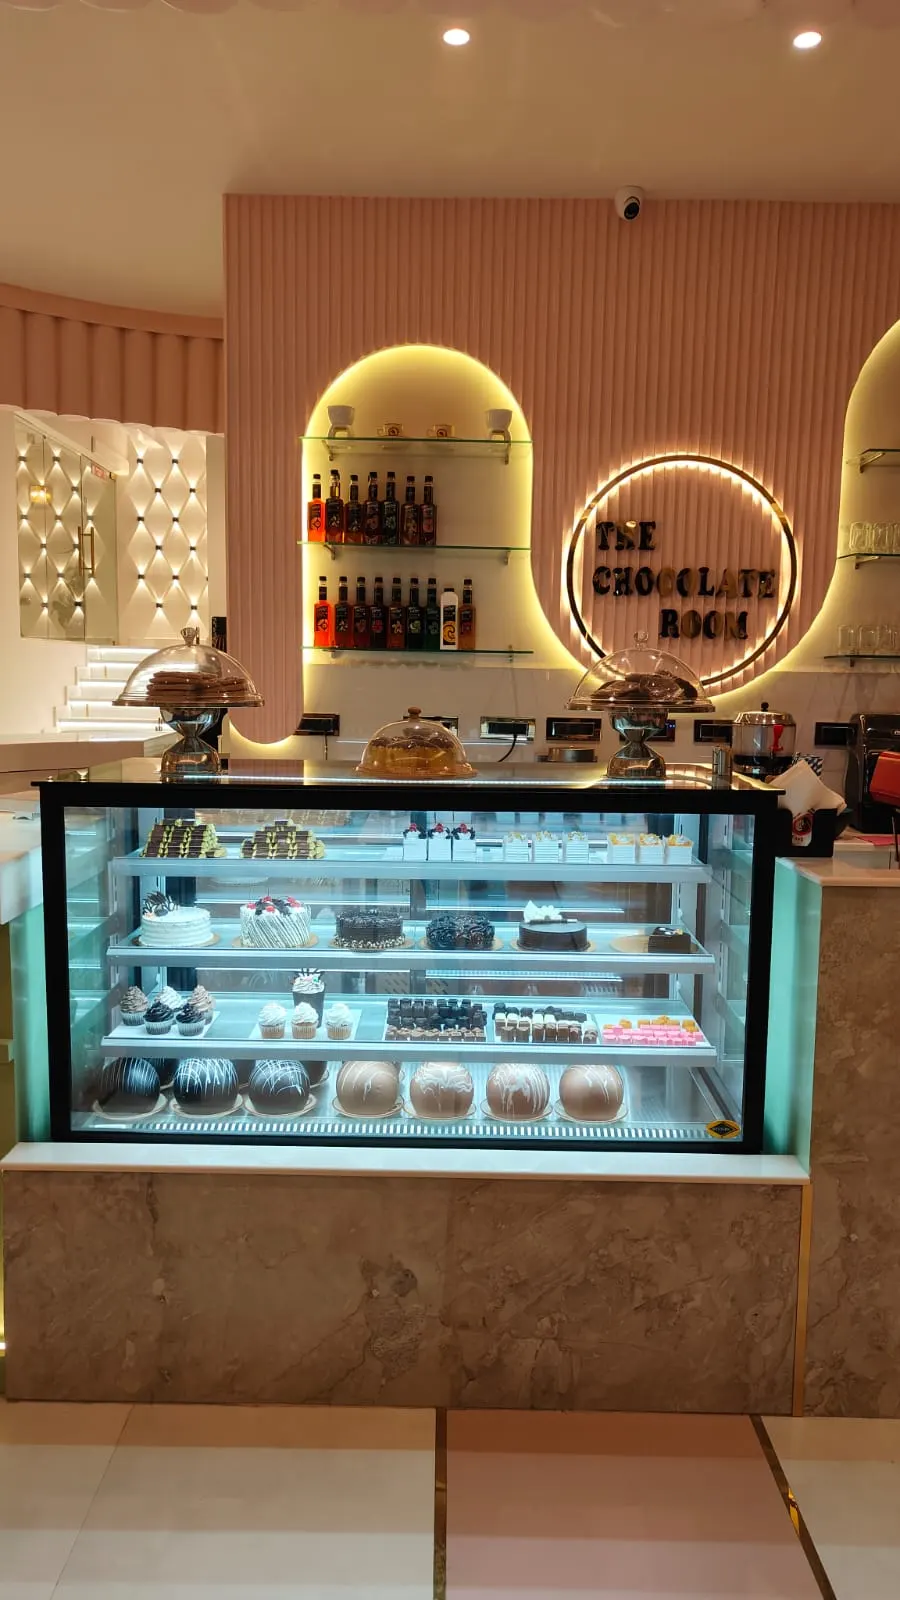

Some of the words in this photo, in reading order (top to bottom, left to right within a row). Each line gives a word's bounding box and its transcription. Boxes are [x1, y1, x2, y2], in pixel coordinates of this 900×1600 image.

[596, 521, 656, 551] THE
[593, 566, 776, 599] CHOCOLATE
[660, 609, 748, 641] ROOM
